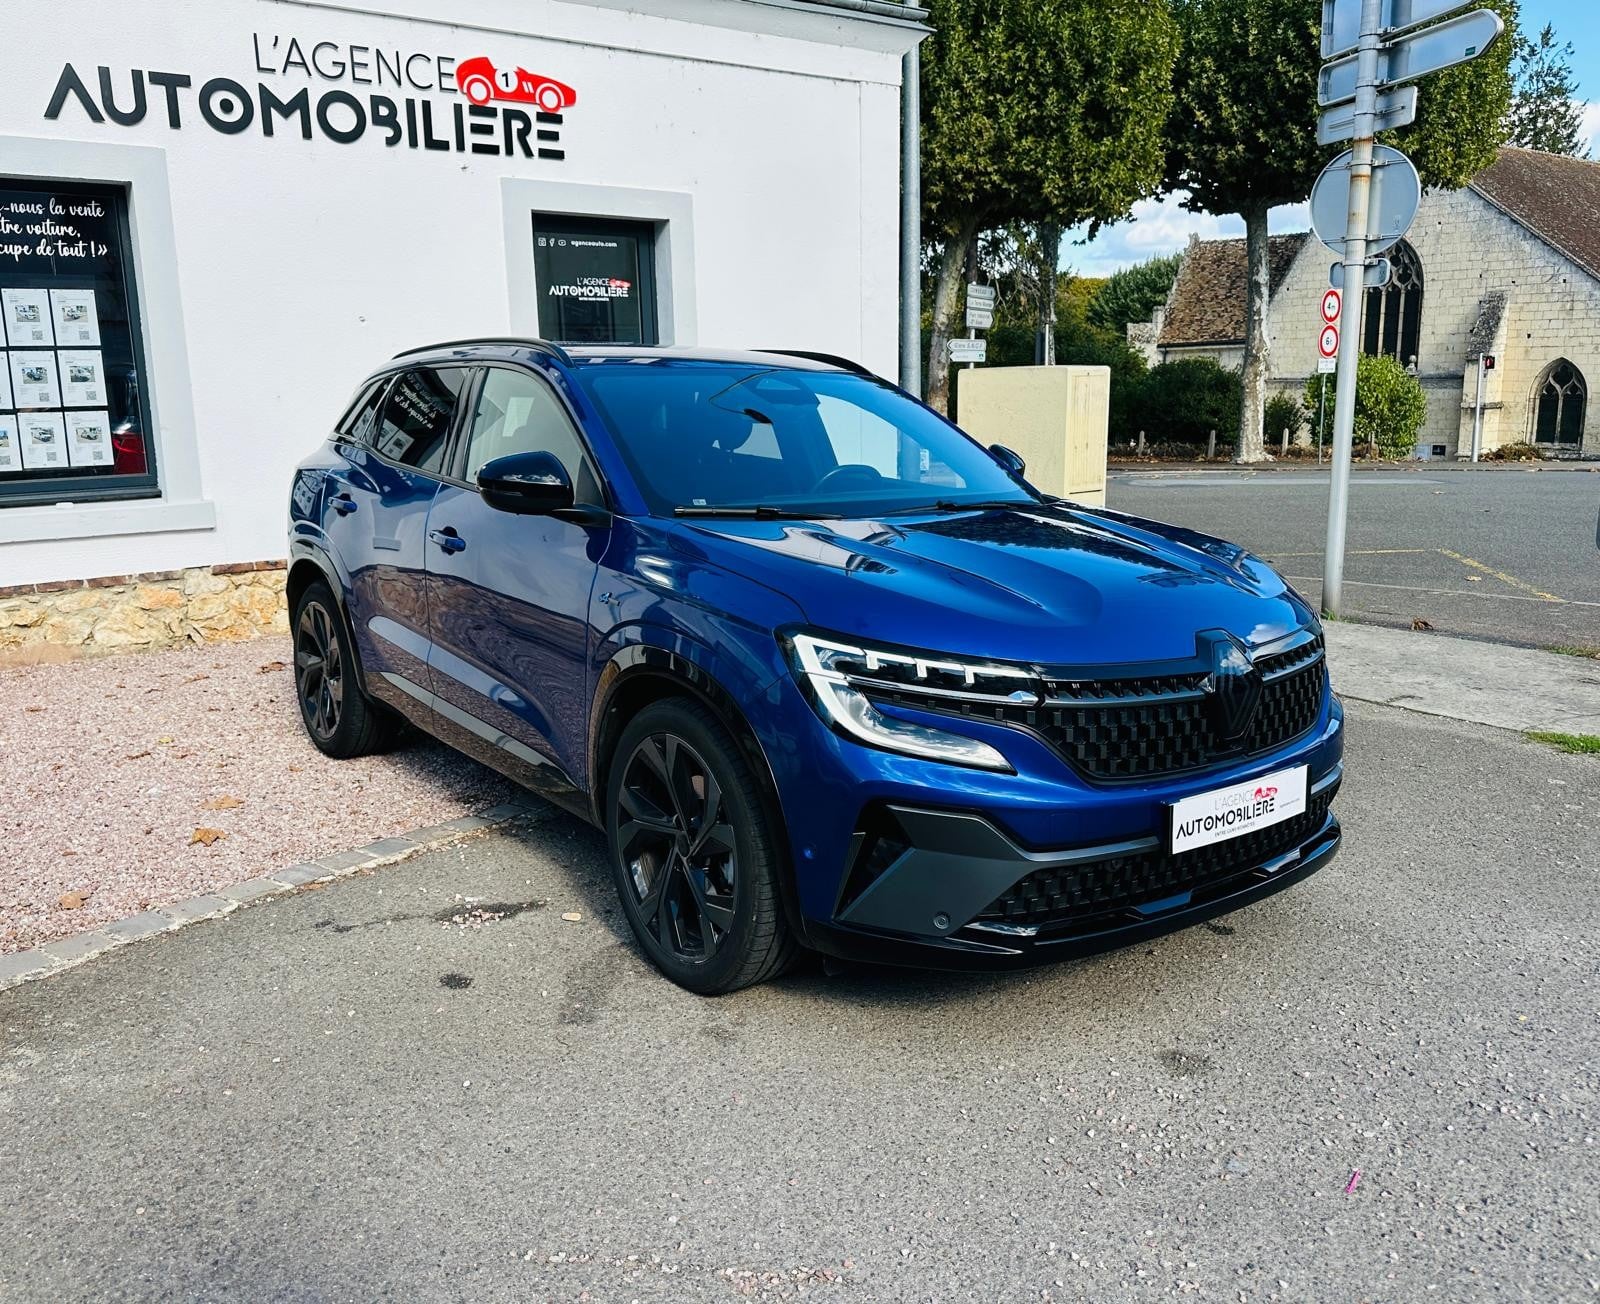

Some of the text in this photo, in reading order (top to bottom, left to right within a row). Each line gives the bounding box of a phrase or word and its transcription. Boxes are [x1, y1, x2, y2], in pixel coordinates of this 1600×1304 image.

[253, 32, 459, 93] L'AGENCE
[501, 71, 510, 88] 1
[49, 197, 67, 216] la
[69, 200, 106, 218] vente
[26, 218, 81, 238] voiture,
[36, 238, 56, 257] de
[53, 239, 89, 258] tout
[577, 277, 611, 286] L'AGENCE
